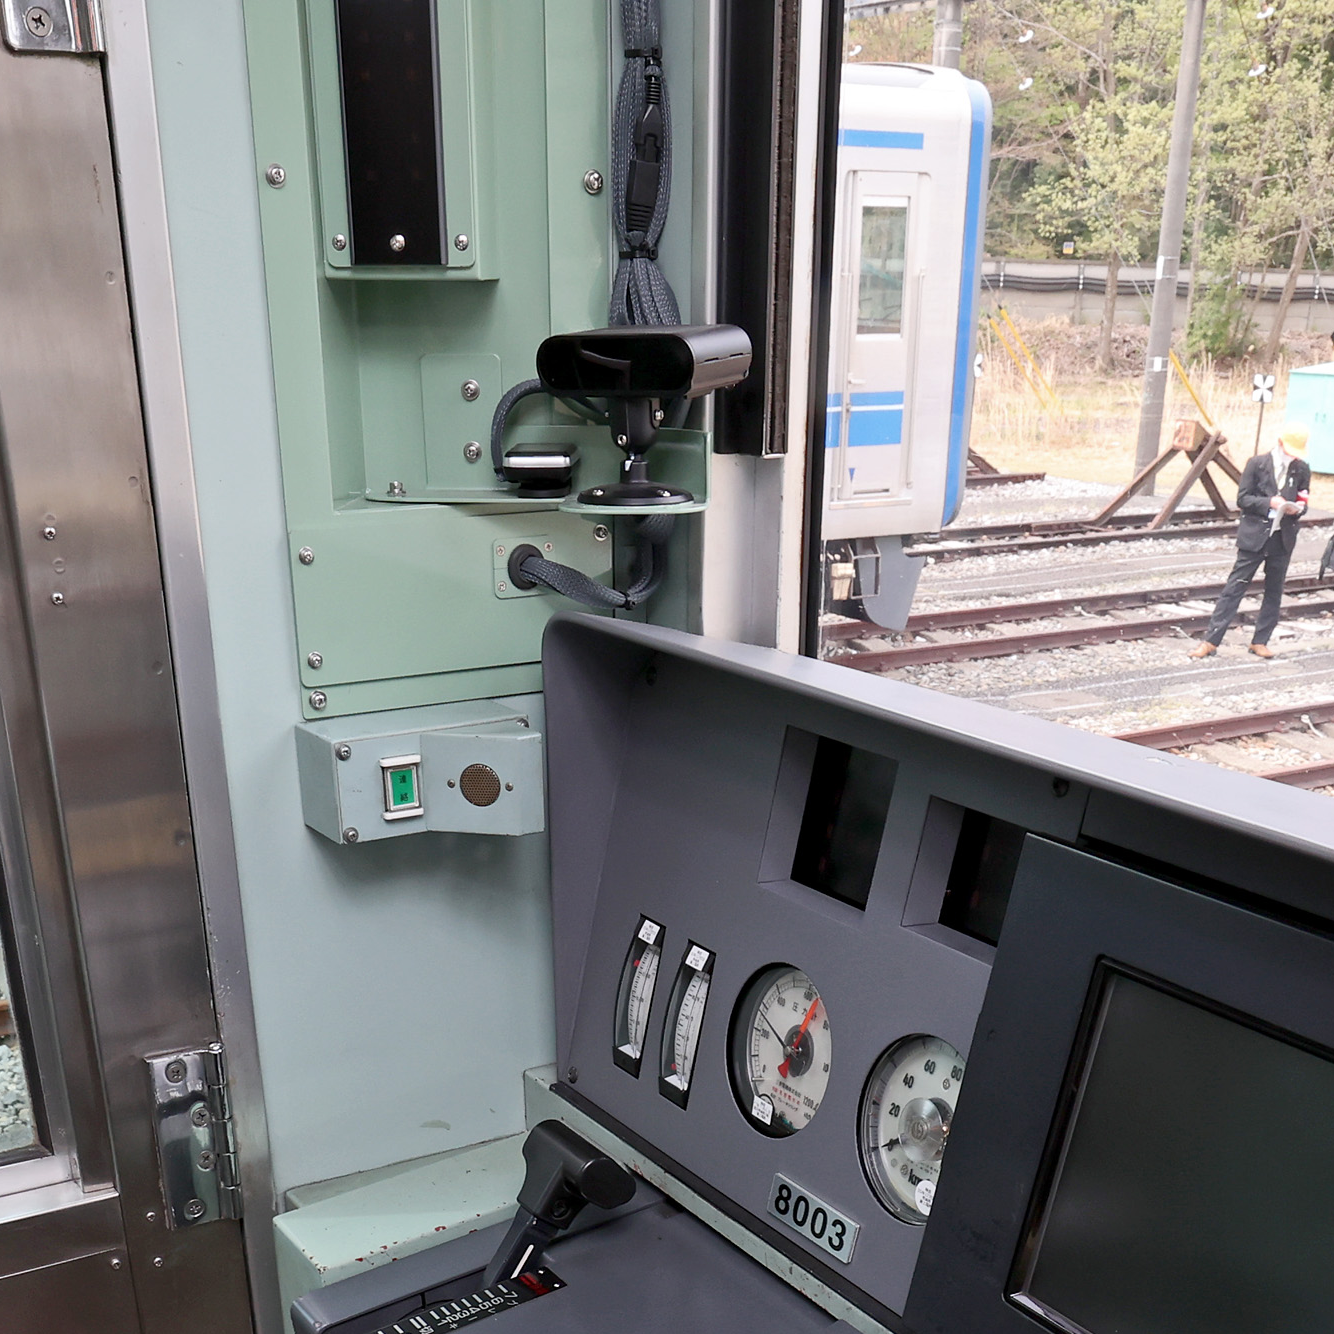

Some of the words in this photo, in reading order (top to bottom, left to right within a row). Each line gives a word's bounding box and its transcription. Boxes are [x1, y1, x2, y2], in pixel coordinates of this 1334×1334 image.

[924, 1059, 936, 1075] 60
[951, 1065, 962, 1082] 80
[903, 1073, 914, 1088] 40
[889, 1103, 900, 1118] 20
[774, 1183, 847, 1252] 8003
[504, 1291, 518, 1299] 7
[480, 1301, 493, 1310] 5
[491, 1296, 505, 1306] 6
[458, 1310, 470, 1319] 3
[470, 1306, 482, 1315] 4
[437, 1318, 450, 1327] 1
[446, 1314, 460, 1323] 2
